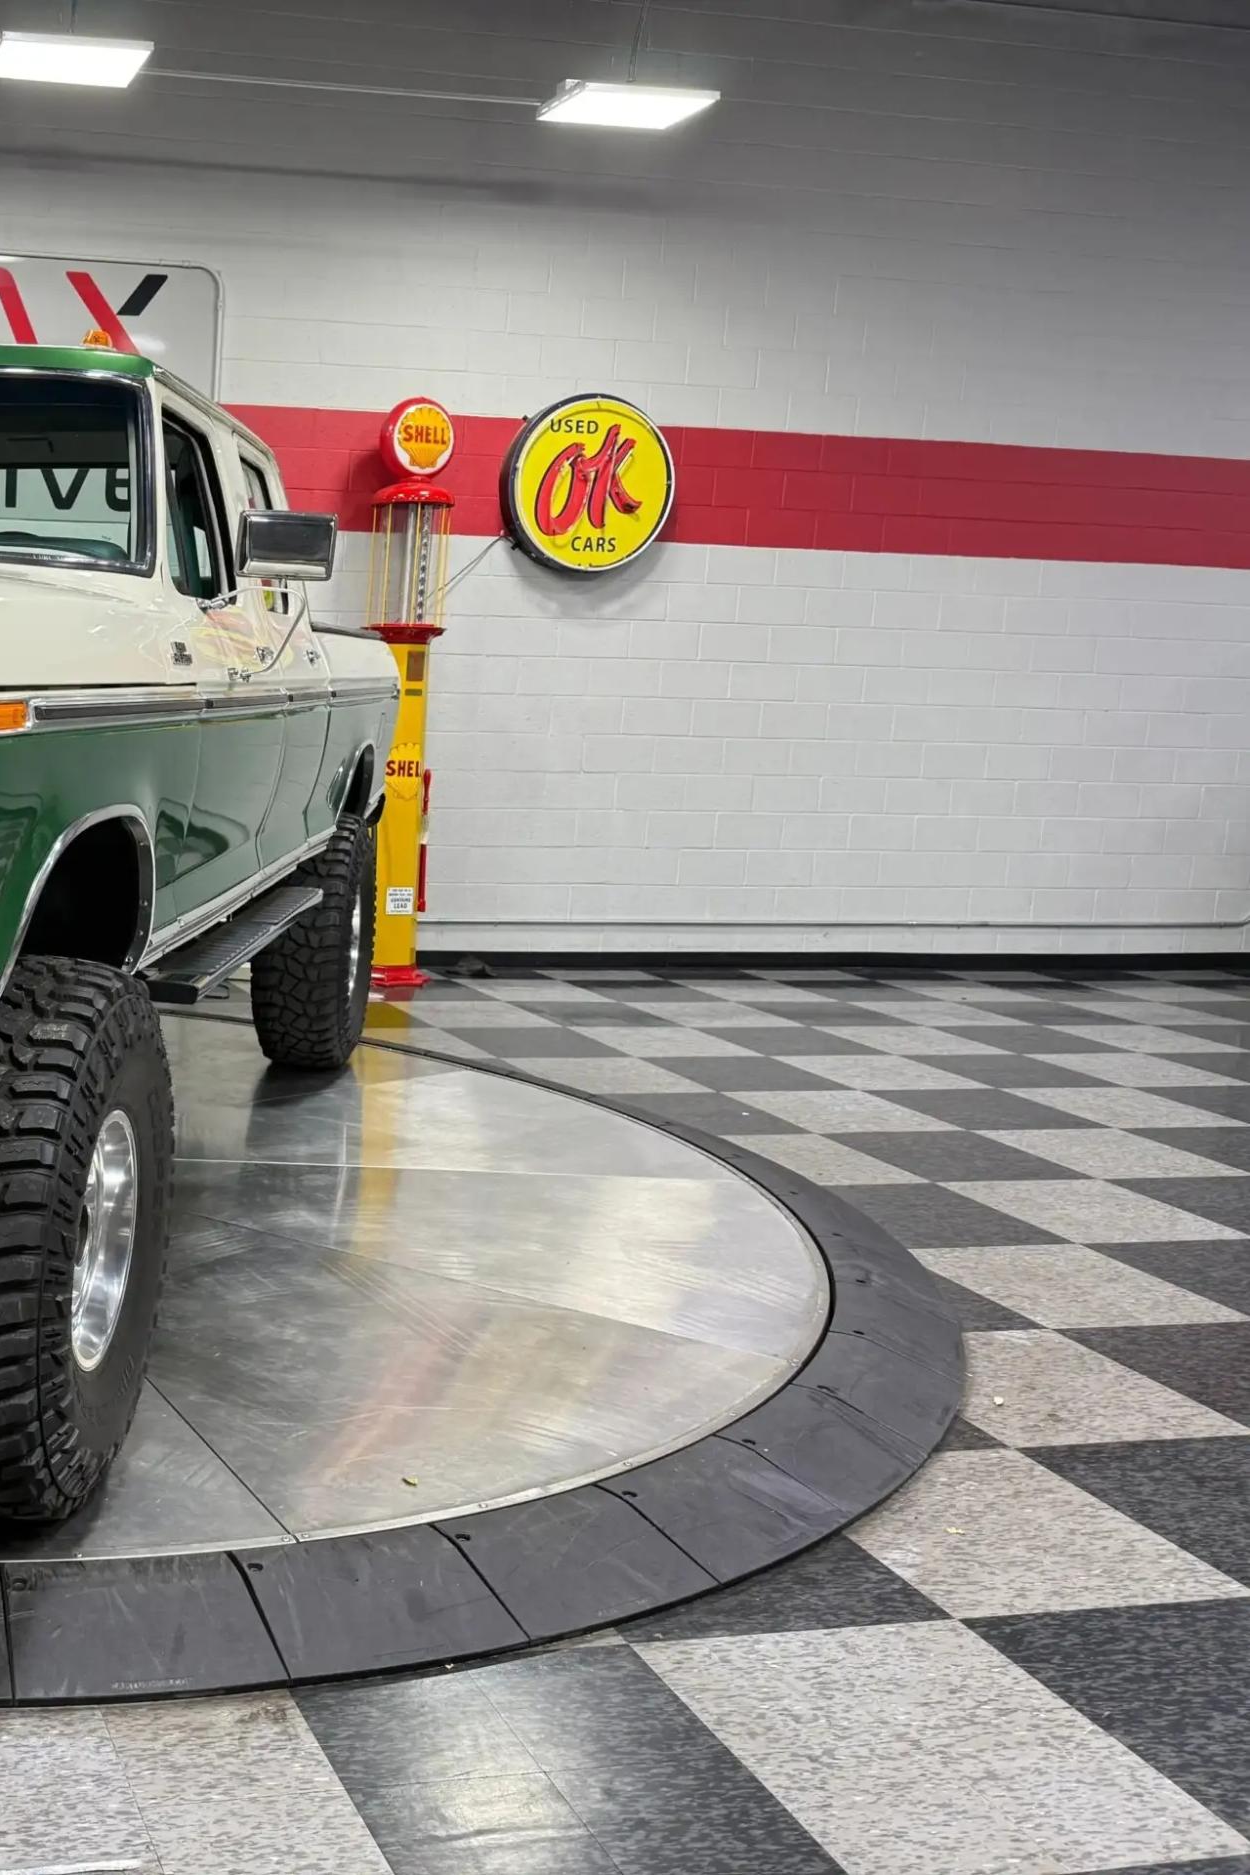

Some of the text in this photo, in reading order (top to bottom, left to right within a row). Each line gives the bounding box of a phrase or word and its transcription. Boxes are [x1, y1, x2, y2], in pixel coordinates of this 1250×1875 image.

[402, 424, 447, 445] SHELL
[550, 419, 598, 434] USED
[535, 424, 642, 536] OK
[571, 536, 616, 552] CARS
[385, 760, 421, 777] SHEL
